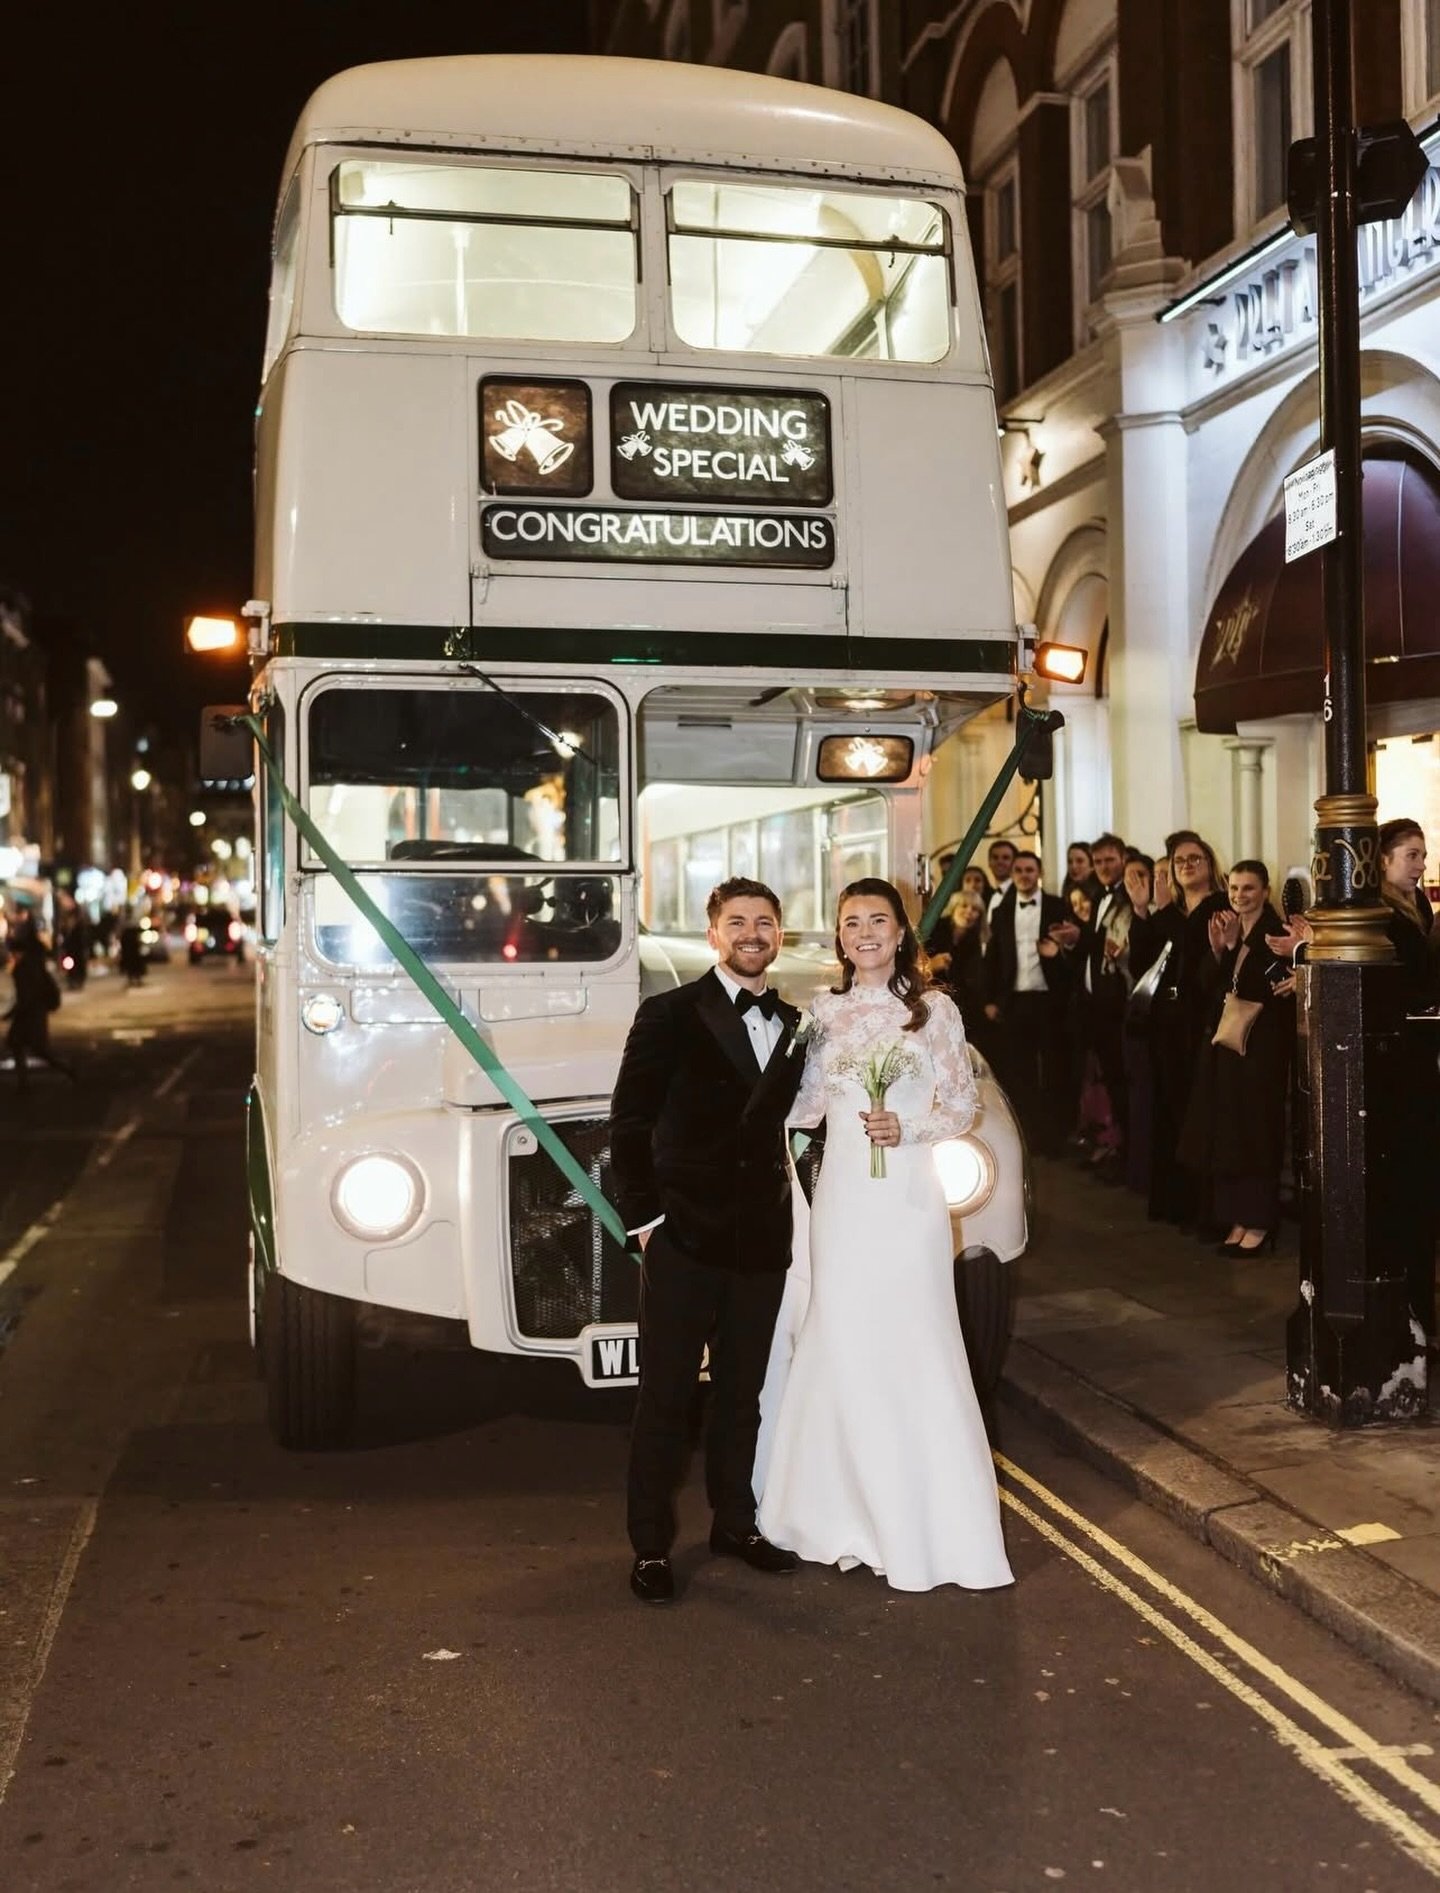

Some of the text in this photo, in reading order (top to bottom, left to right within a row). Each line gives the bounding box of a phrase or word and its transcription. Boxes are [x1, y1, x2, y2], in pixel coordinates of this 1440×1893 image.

[629, 401, 808, 440] WEDDING
[653, 448, 790, 483] SPECIAL
[491, 511, 828, 549] CONGRATULATIONS
